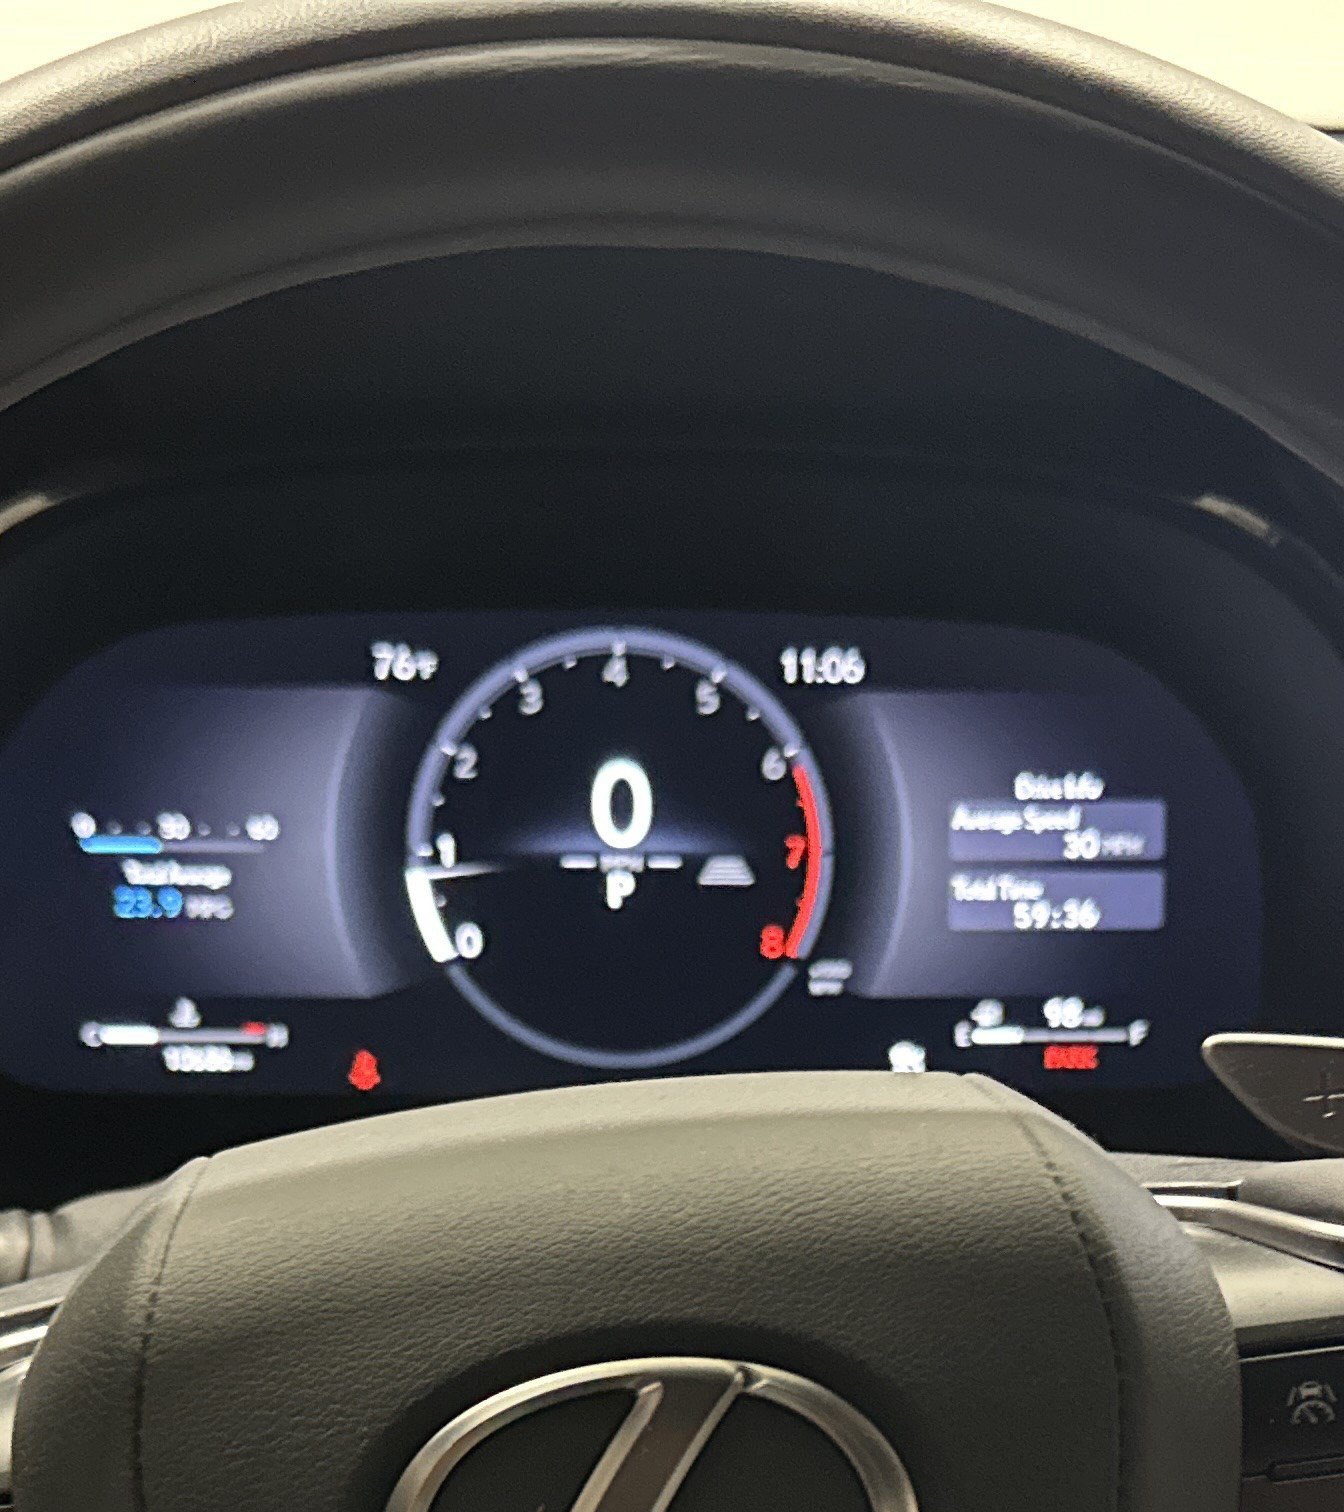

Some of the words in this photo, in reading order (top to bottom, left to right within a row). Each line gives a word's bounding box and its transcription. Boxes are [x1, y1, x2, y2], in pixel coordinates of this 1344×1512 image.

[602, 654, 628, 688] 4
[780, 647, 865, 685] 11:06
[519, 681, 543, 715] 3
[695, 682, 721, 715] 5
[453, 745, 479, 779] 2
[762, 746, 786, 780] 6
[590, 758, 653, 849] 0
[437, 832, 456, 868] 1
[785, 834, 806, 869] 7
[1063, 828, 1101, 859] 30
[607, 871, 635, 909] P
[1013, 898, 1101, 930] 59:36
[457, 922, 484, 959] 0
[760, 924, 785, 959] 8
